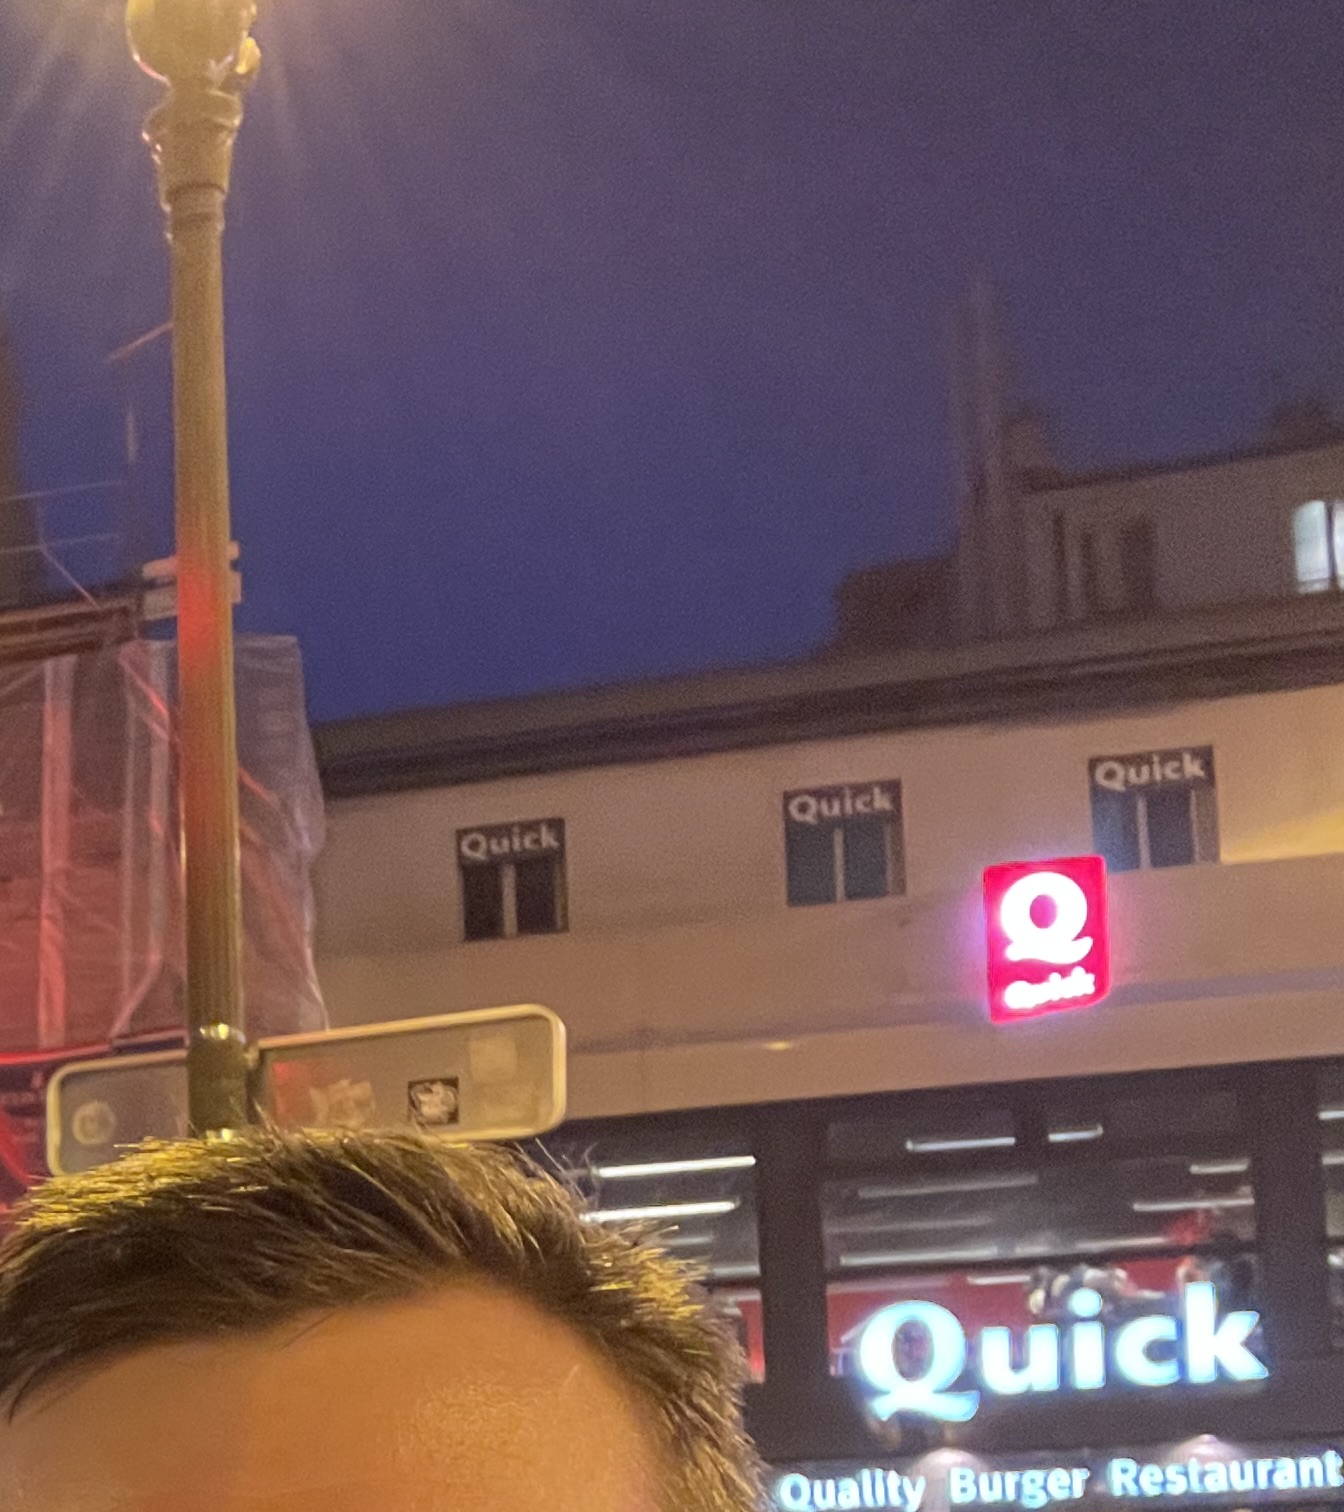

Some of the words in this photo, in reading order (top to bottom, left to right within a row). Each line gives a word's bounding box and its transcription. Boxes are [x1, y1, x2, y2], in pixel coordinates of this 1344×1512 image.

[1094, 751, 1207, 791] Quick
[787, 784, 894, 825] Quick
[461, 823, 560, 861] Quick
[999, 870, 1093, 964] Q
[857, 1281, 1269, 1422] Quick
[950, 1466, 1090, 1509] Burger
[1110, 1450, 1343, 1497] Restaurant
